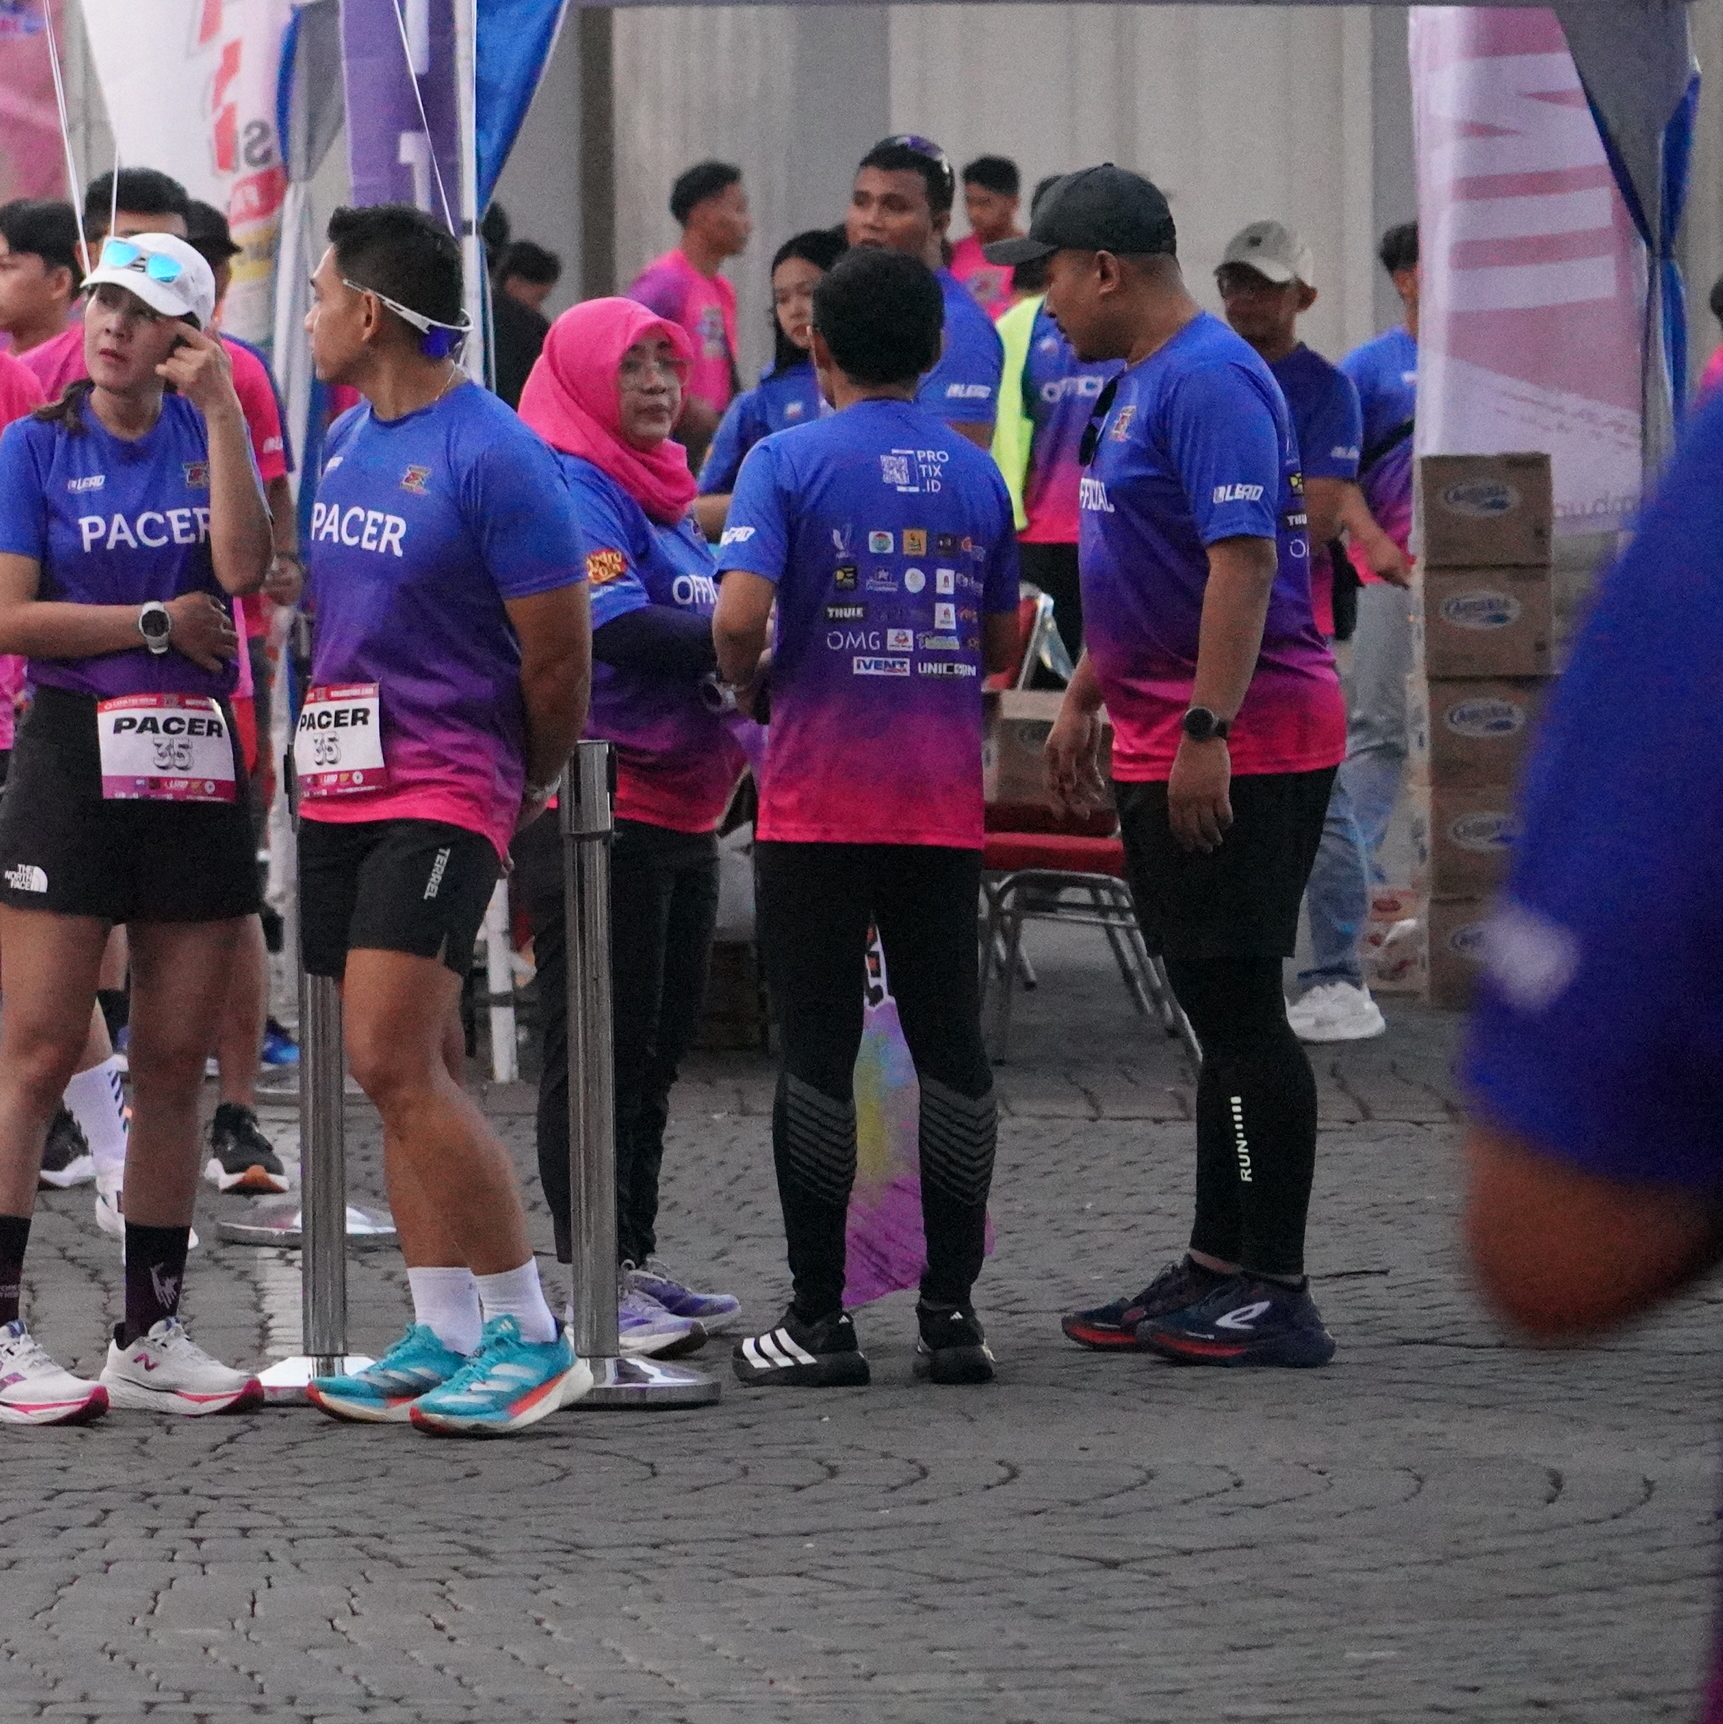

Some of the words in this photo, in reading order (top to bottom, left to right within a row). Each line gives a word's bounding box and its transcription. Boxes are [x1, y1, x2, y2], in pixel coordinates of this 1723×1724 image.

[916, 450, 949, 463] PRO
[919, 464, 943, 478] TIX
[79, 506, 212, 554] PACER
[312, 502, 407, 557] PACER
[826, 630, 881, 651] OMG
[112, 716, 225, 738] PACER
[298, 707, 371, 731] PACER
[4, 870, 34, 882] NORTH
[16, 863, 34, 873] THE
[10, 880, 33, 892] FACE
[1235, 1139, 1253, 1183] RUN
